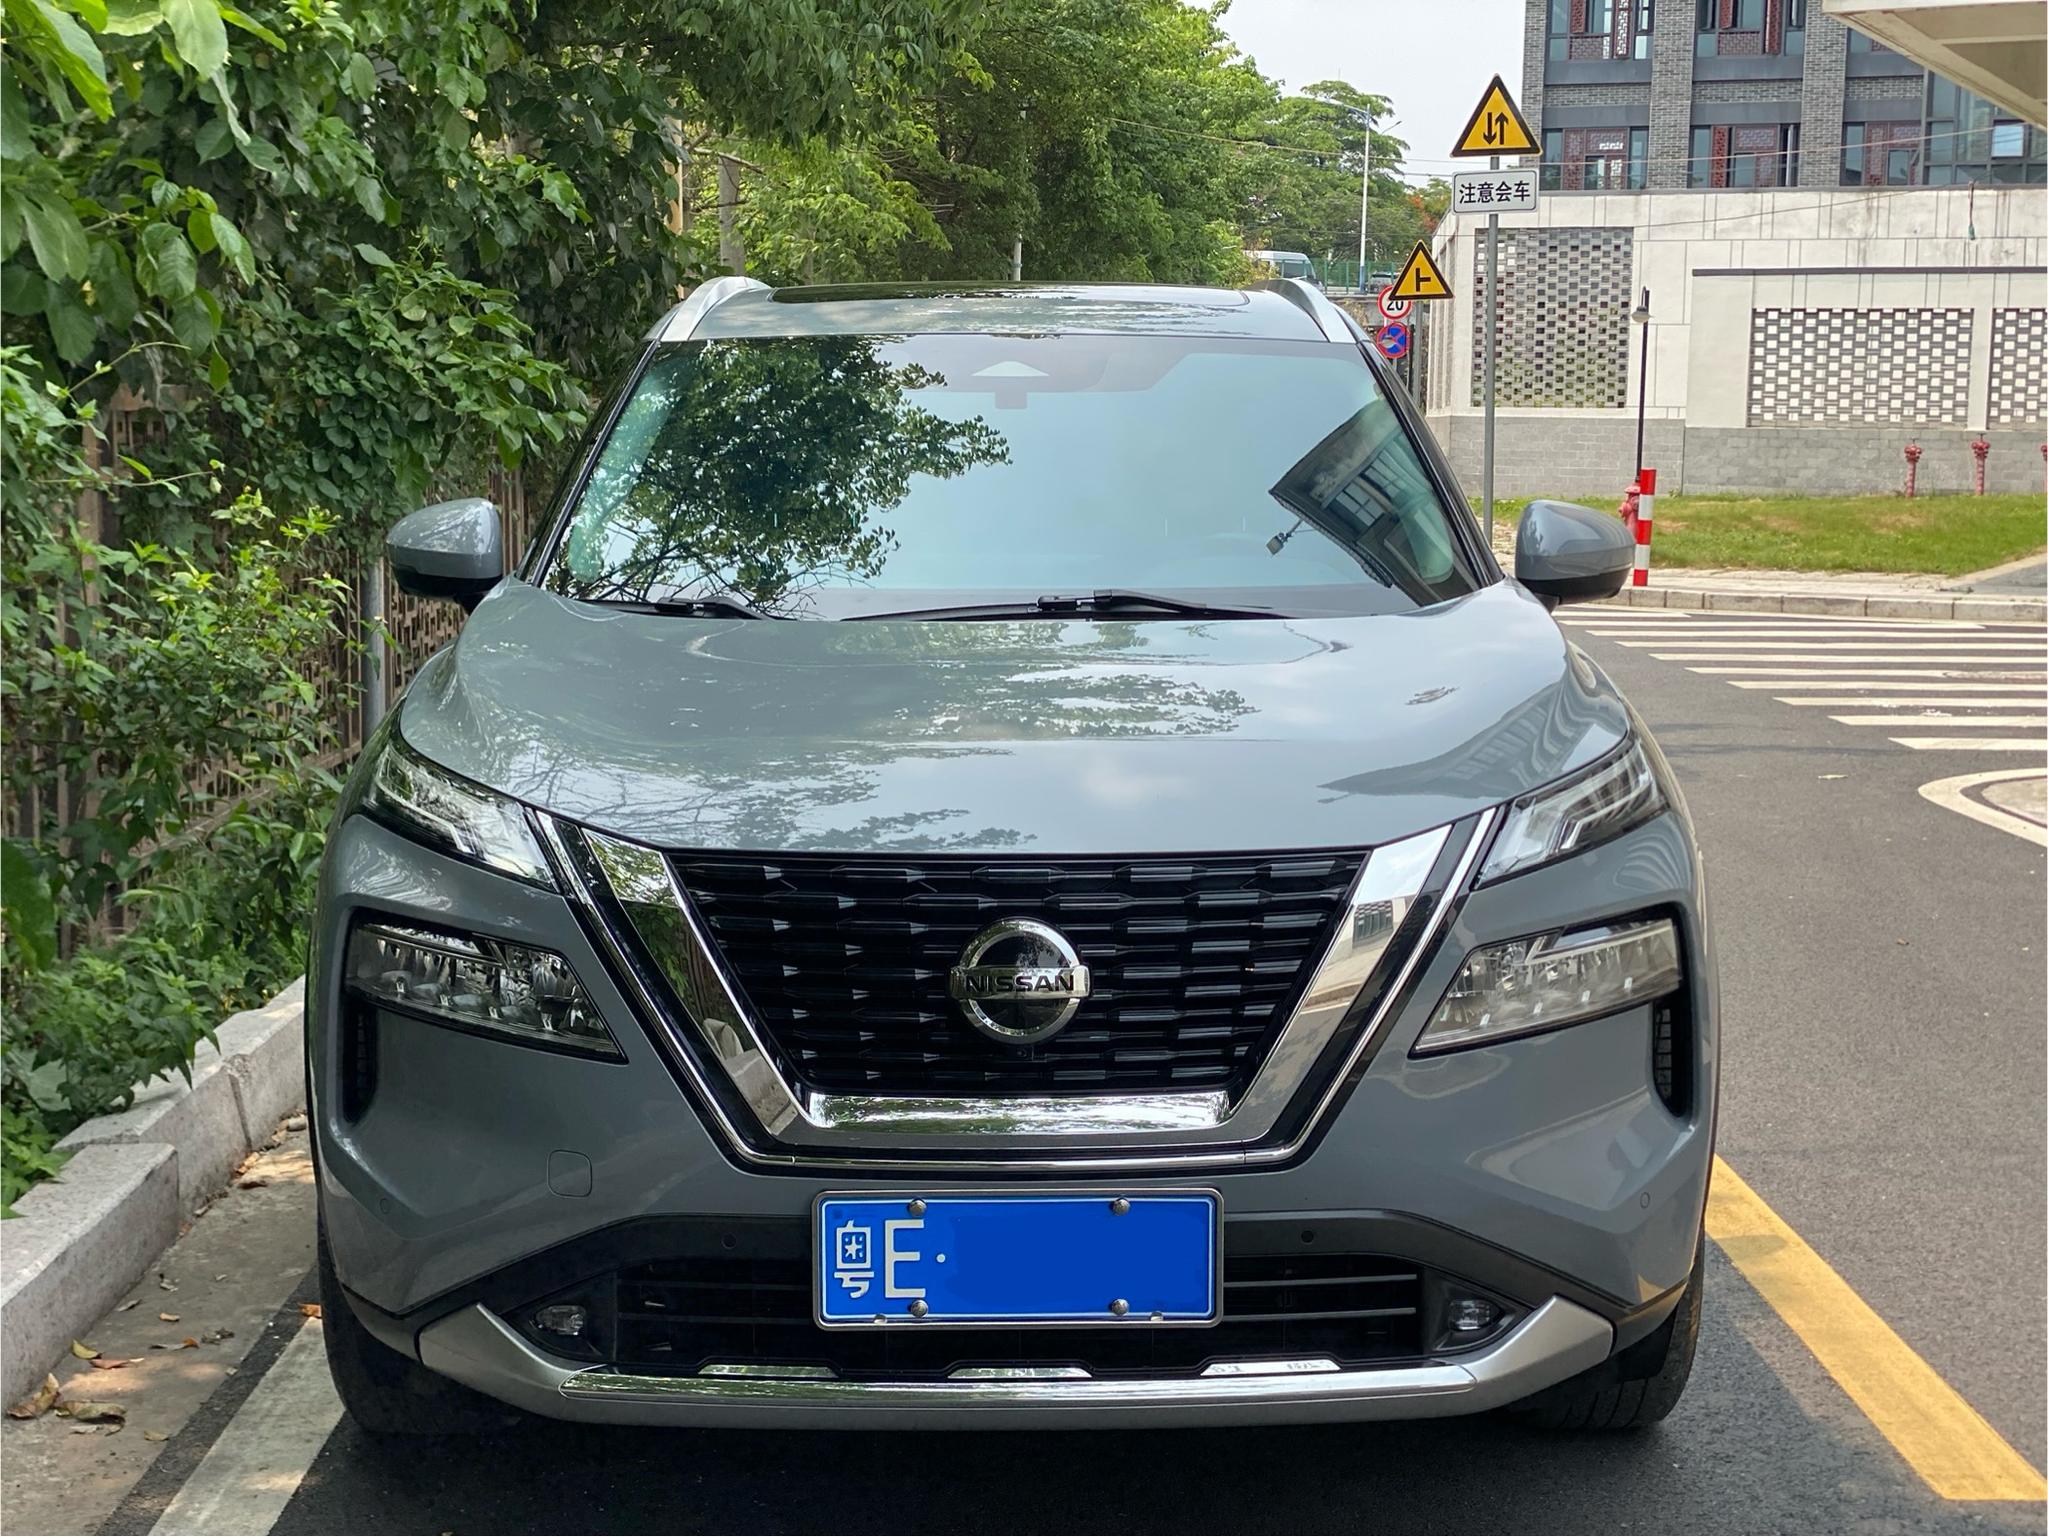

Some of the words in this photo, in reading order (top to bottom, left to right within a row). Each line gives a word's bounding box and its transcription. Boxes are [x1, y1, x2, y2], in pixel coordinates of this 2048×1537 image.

[1459, 180, 1531, 204] 注意会车
[965, 975, 1075, 992] NISSAN
